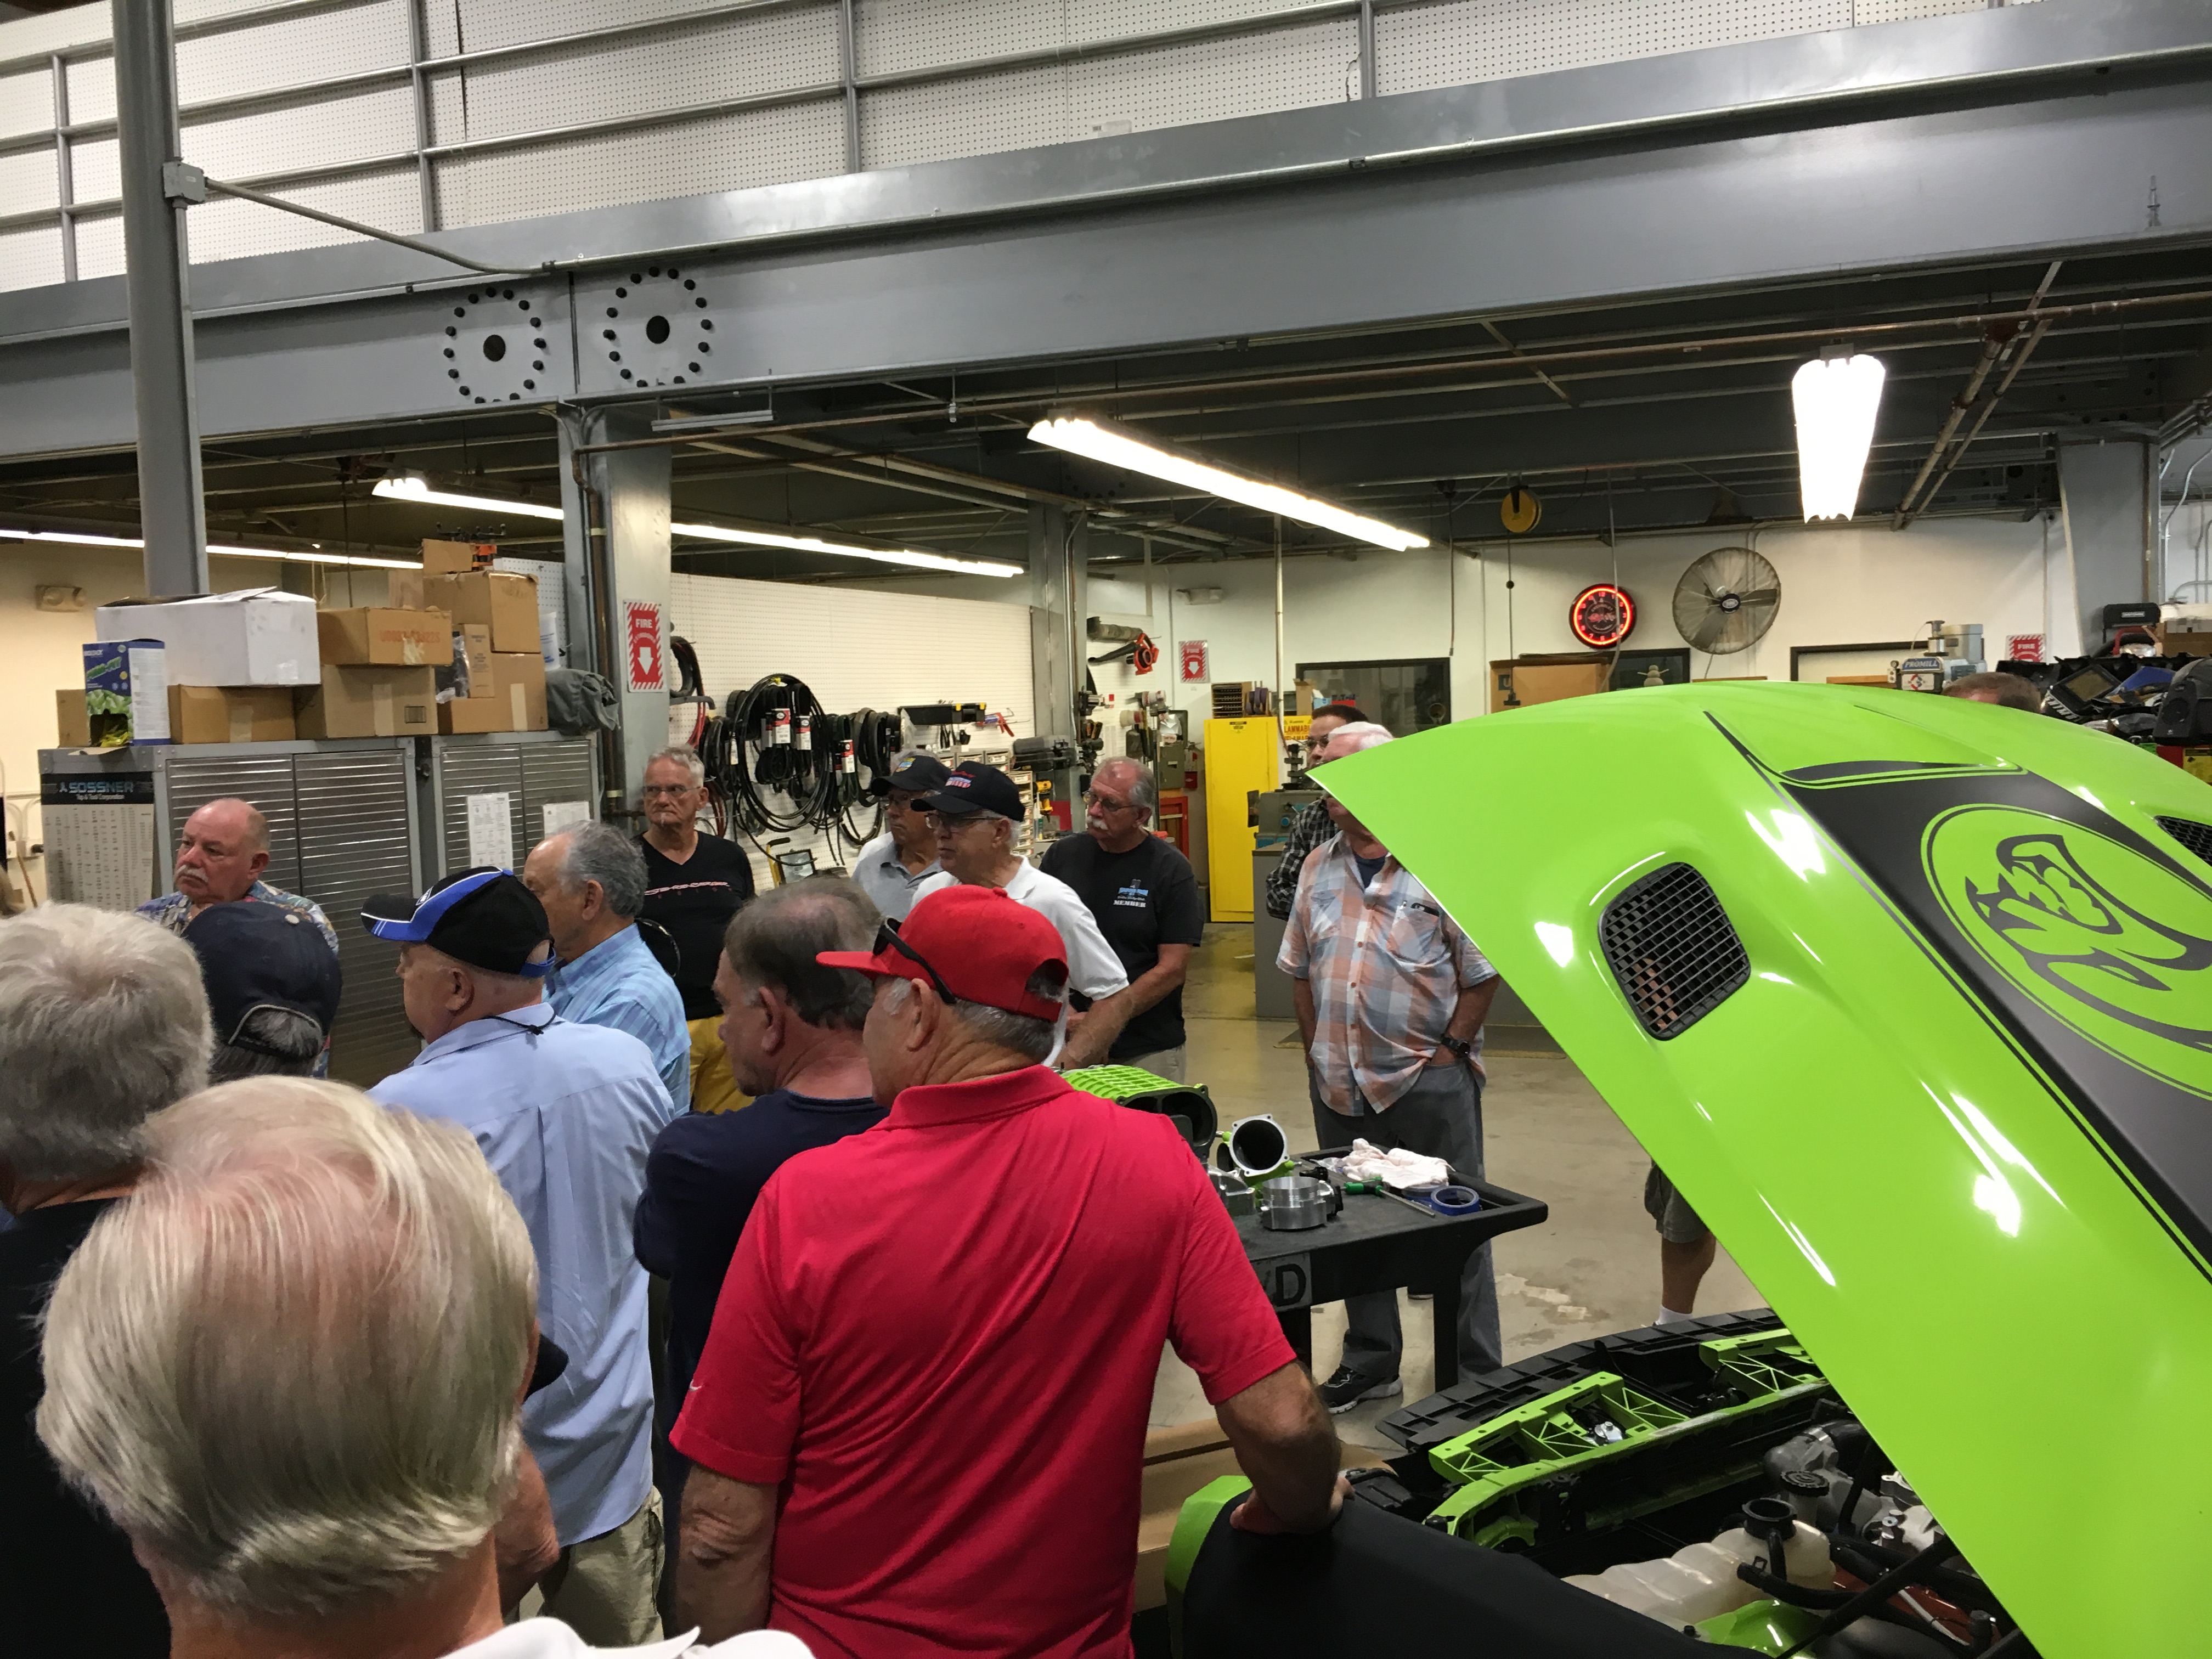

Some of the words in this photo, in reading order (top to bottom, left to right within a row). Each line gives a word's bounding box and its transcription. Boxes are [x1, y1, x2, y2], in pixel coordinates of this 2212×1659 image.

[635, 618, 653, 628] FIRE
[68, 781, 134, 793] SOSSNER
[1113, 900, 1146, 908] MEMBER
